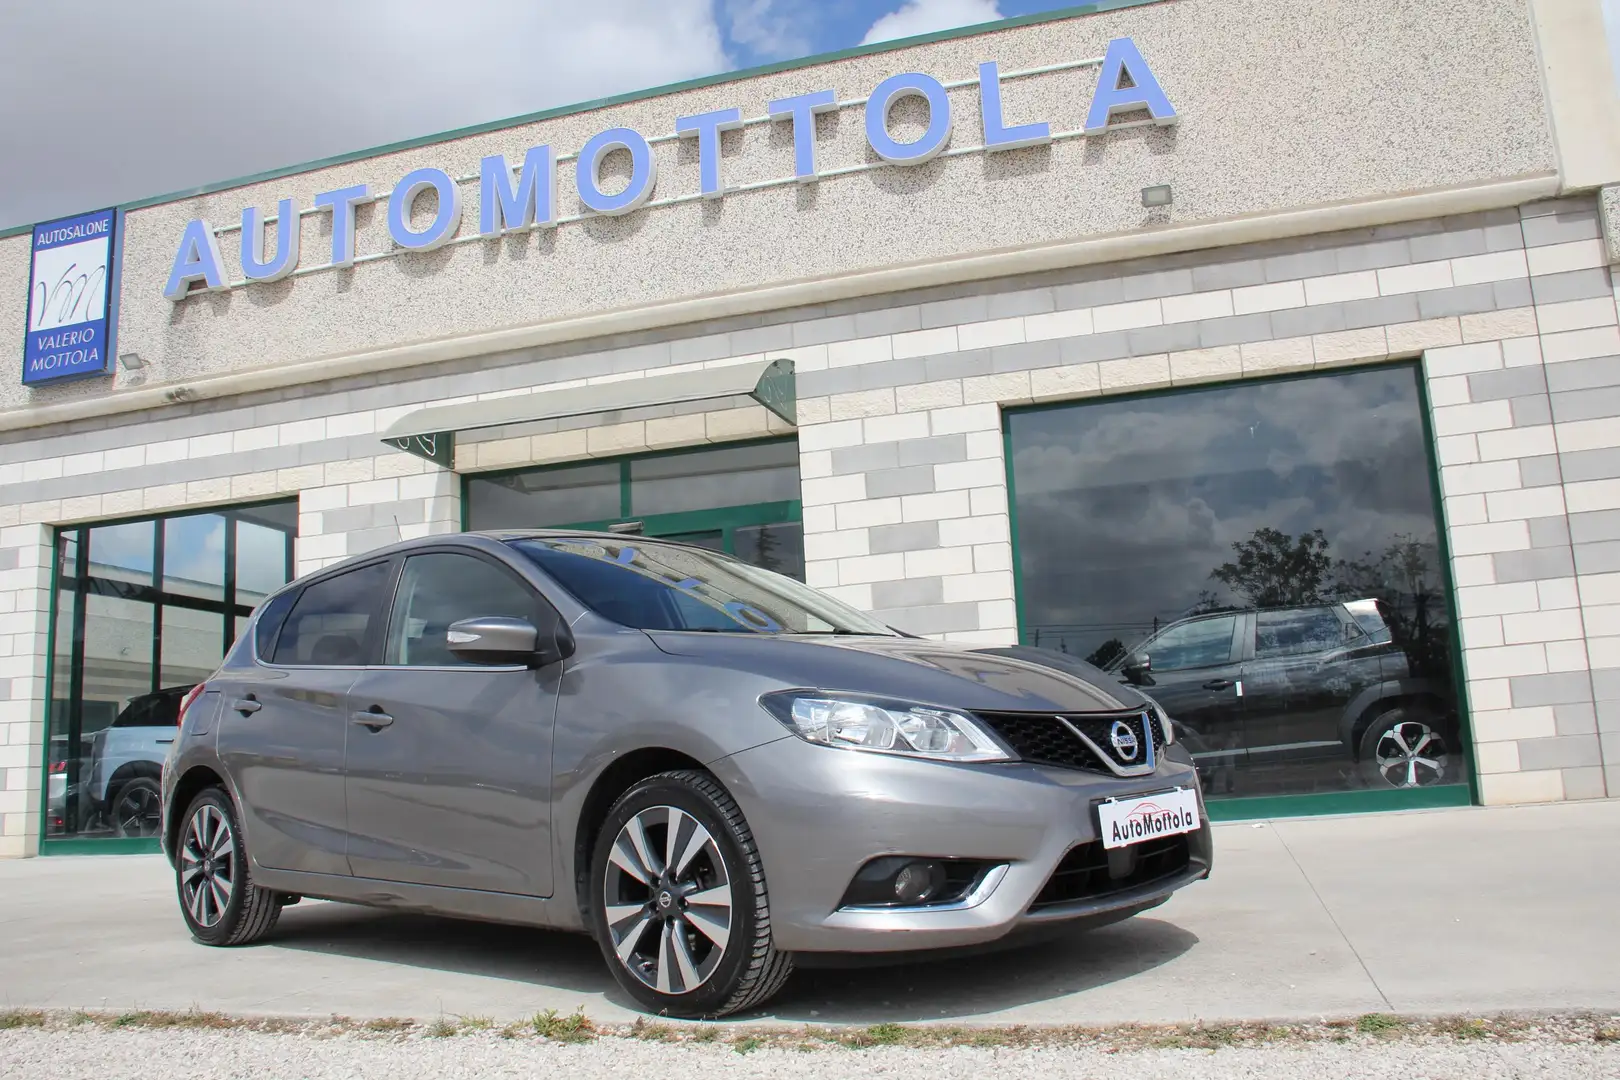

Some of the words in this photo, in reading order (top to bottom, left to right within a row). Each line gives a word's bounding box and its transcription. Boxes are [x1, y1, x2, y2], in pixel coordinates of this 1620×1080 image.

[163, 38, 1178, 300] AUTOMOTTOLA
[37, 218, 109, 246] AUTOSALONE
[37, 327, 95, 350] VALERIO
[30, 347, 99, 372] MOTTOLA
[1112, 806, 1193, 842] AutoMottola
